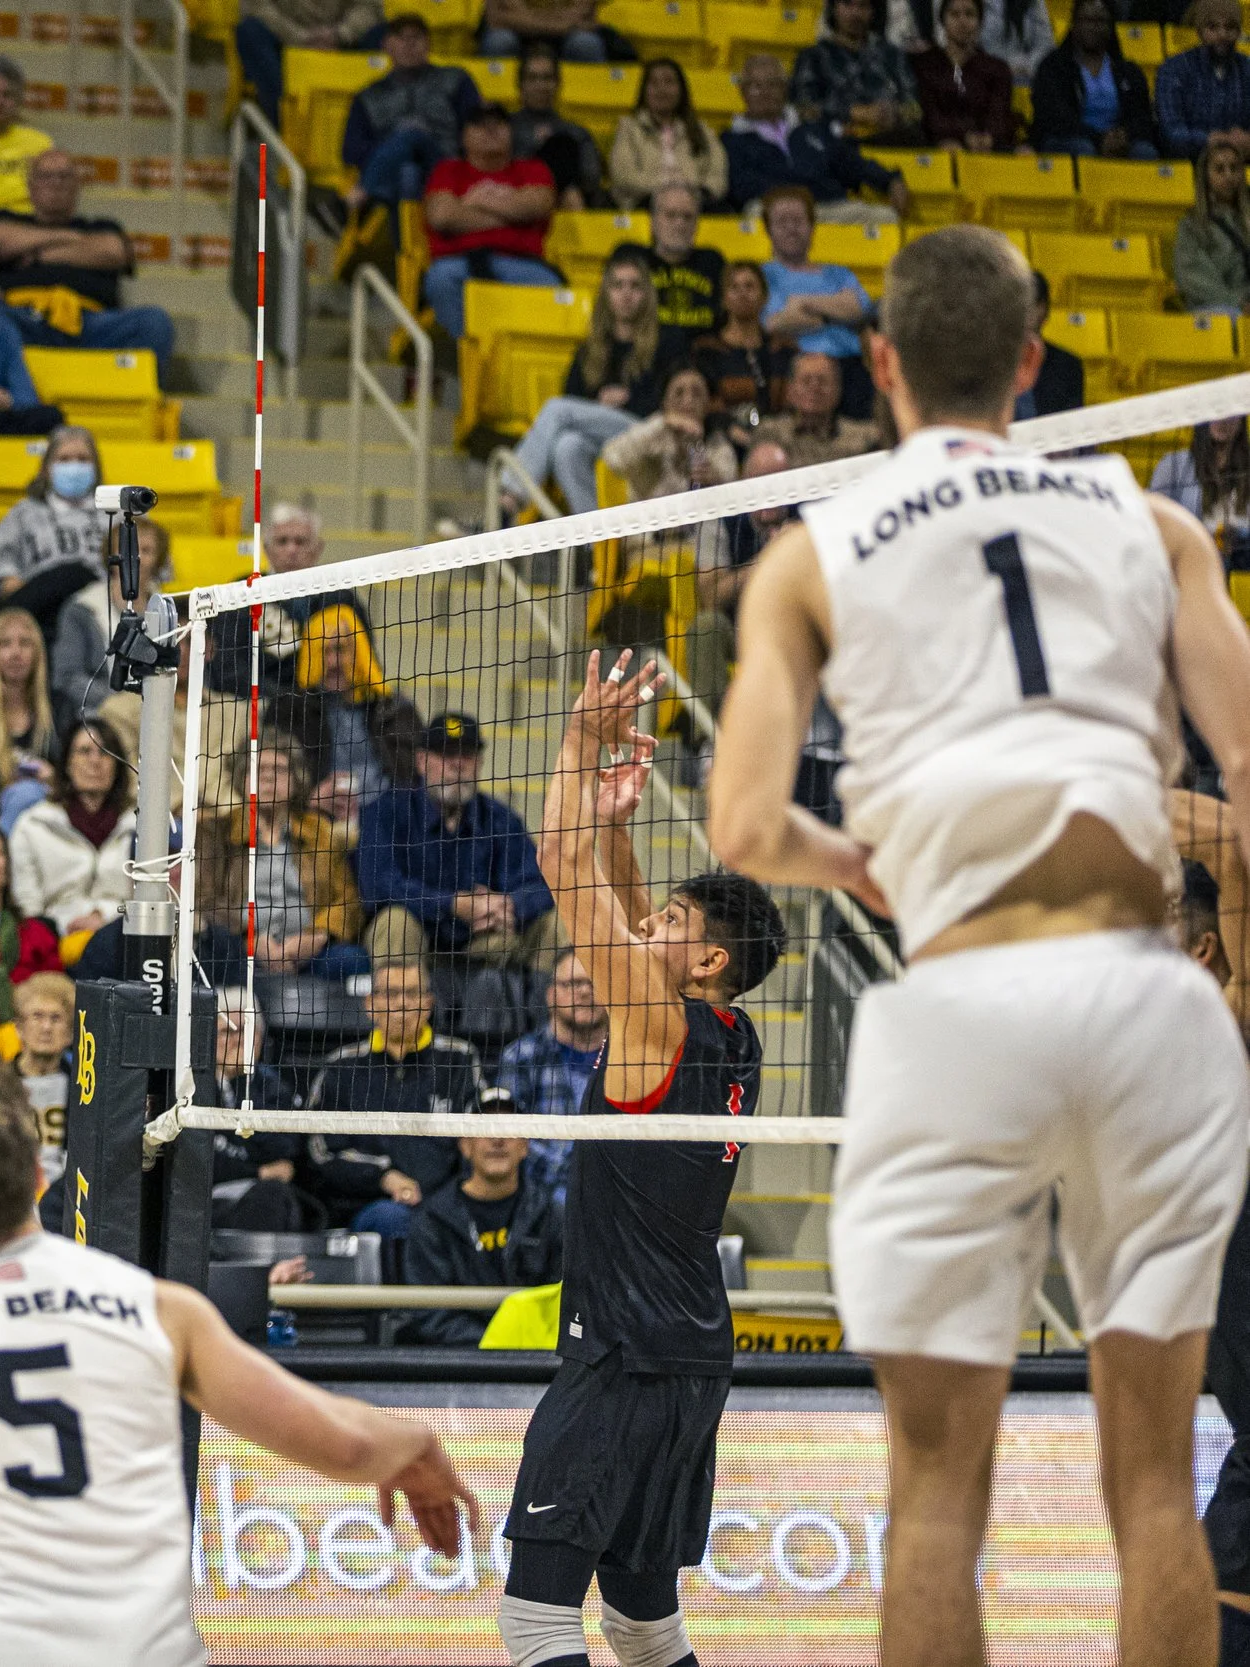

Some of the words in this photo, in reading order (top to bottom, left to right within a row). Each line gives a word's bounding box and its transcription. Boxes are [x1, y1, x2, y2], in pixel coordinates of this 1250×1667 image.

[852, 478, 962, 560] LONG
[975, 467, 1123, 512] BEACH
[982, 530, 1049, 697] 1
[5, 1288, 143, 1329] BEACH
